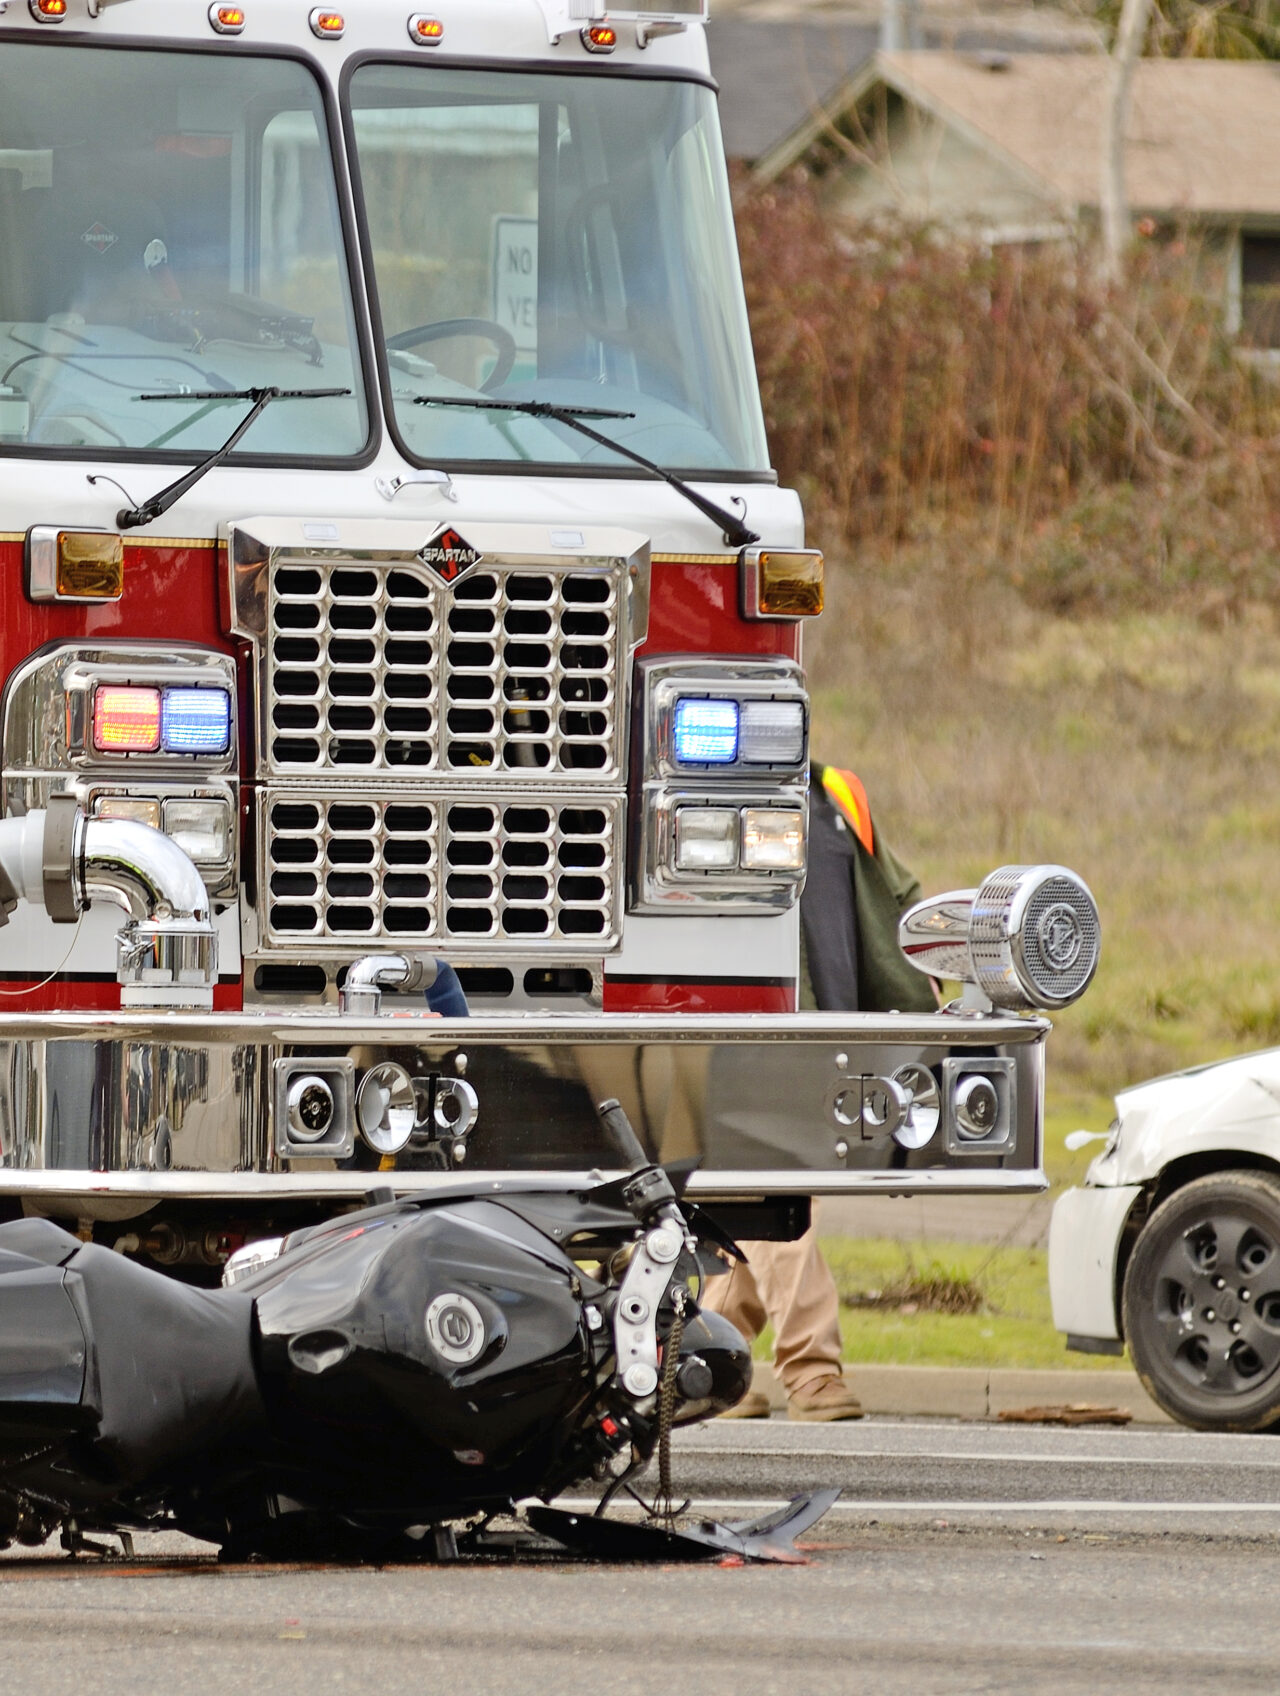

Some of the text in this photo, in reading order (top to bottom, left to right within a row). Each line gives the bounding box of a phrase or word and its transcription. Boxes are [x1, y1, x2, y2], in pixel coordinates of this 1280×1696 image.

[507, 246, 532, 275] NO
[507, 295, 534, 328] VE
[423, 547, 476, 562] SPARTAN
